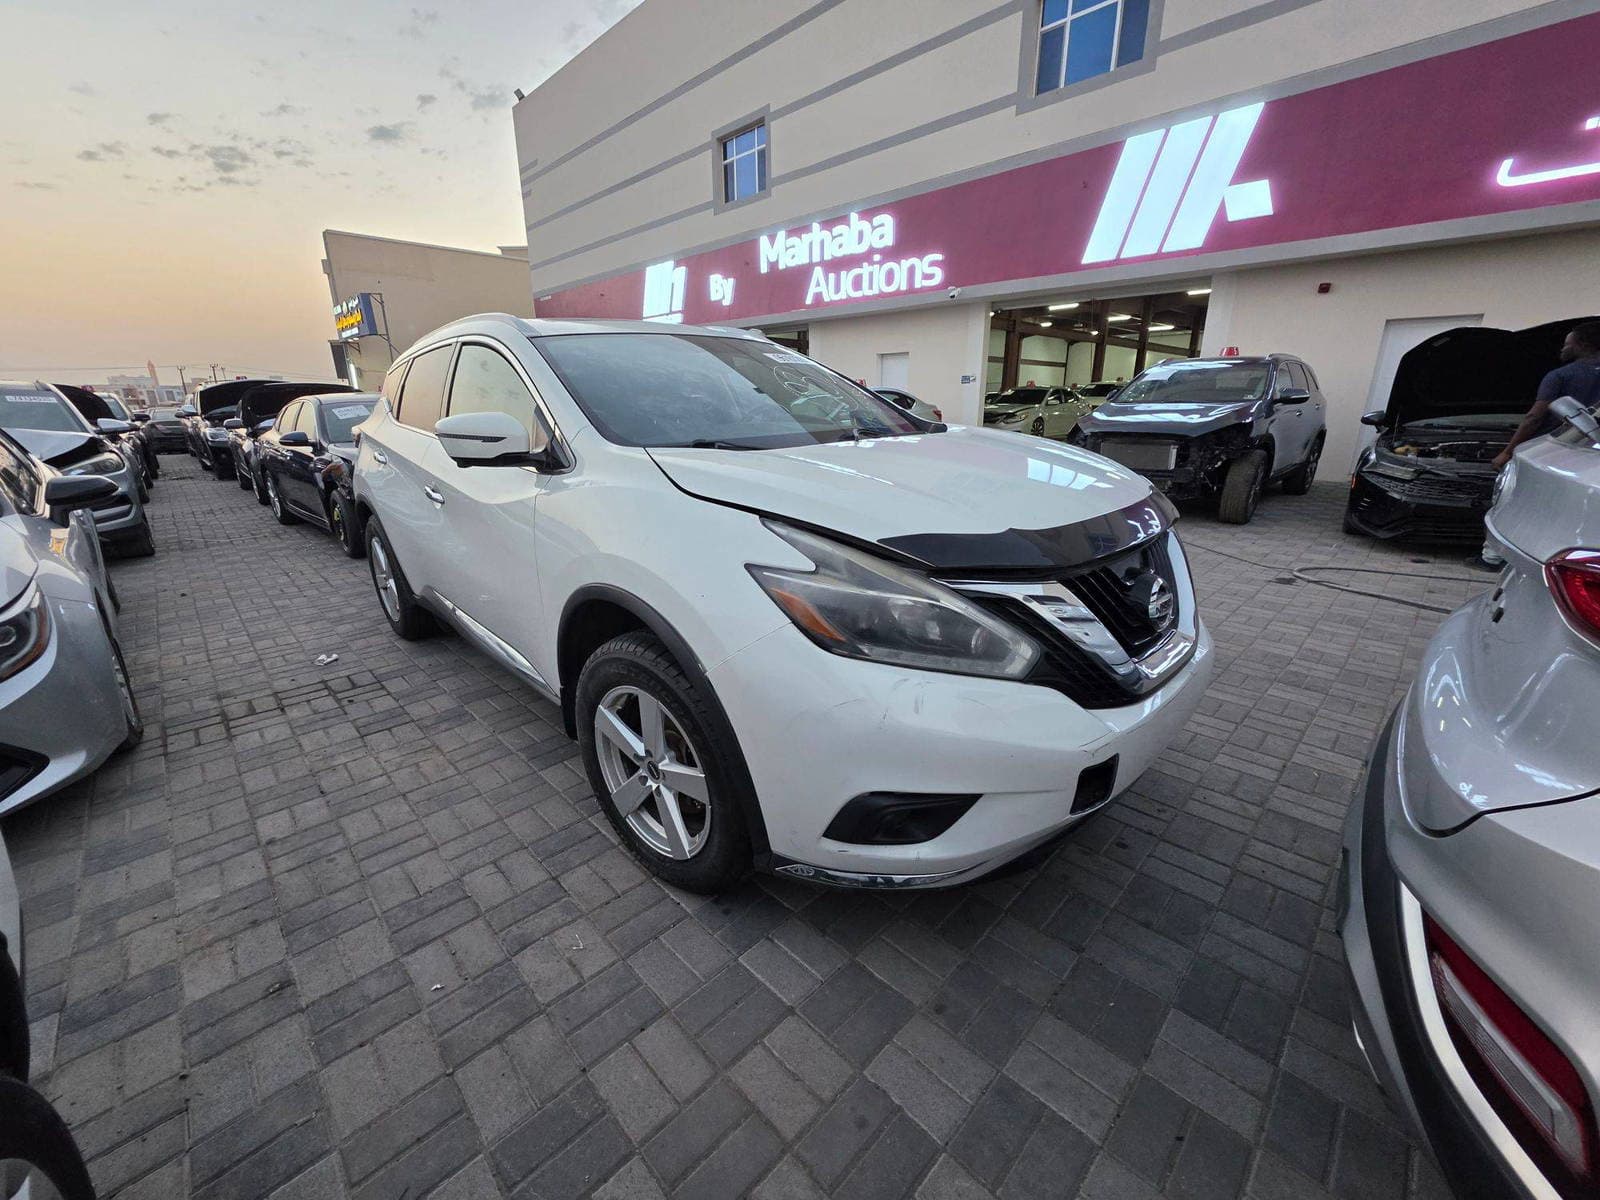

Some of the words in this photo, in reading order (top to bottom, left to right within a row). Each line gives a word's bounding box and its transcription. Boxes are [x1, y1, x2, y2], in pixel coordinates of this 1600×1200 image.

[759, 212, 894, 274] Marhaba
[709, 273, 734, 306] By
[805, 254, 943, 305] Auctions
